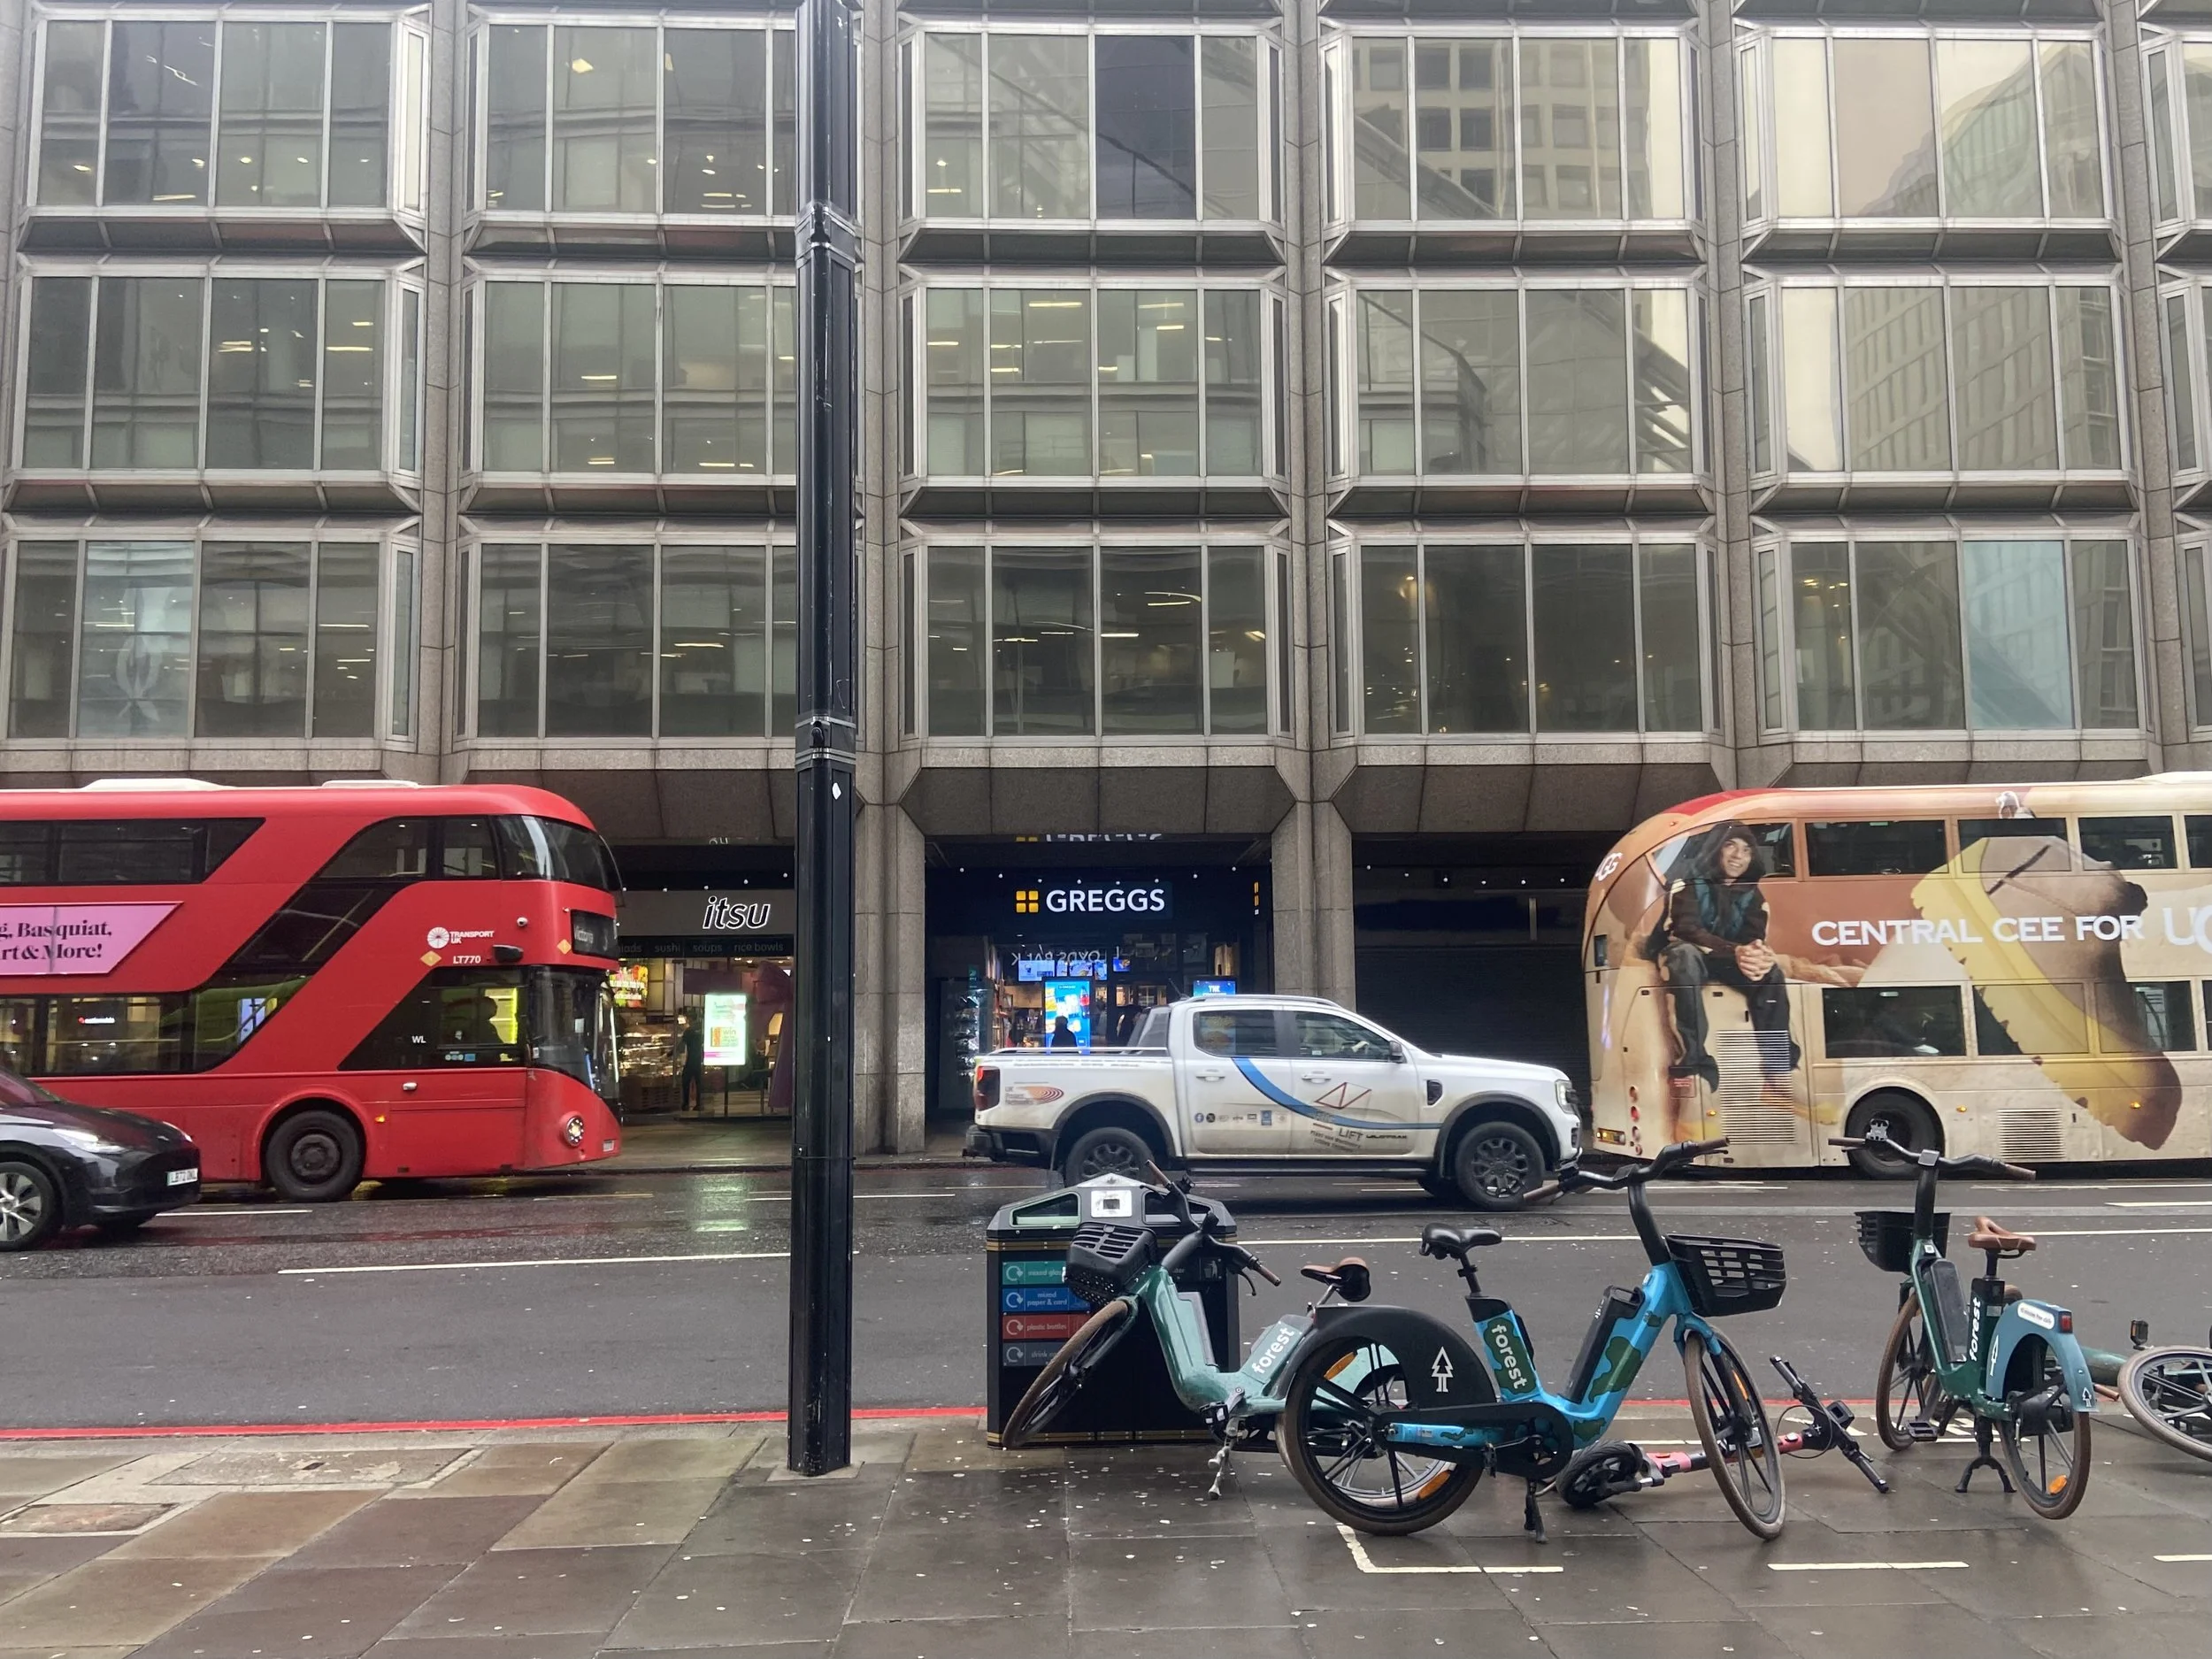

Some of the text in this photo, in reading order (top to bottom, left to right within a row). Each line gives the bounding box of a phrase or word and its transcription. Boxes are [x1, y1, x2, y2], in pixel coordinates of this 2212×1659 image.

[1046, 888, 1165, 912] GREGGS
[703, 895, 771, 929] itsu
[18, 919, 112, 940] Basquiat,
[1811, 918, 1984, 946] CENTRAL
[1992, 916, 2066, 942] CEE
[2075, 914, 2146, 941] FOR
[0, 943, 103, 960] rt & More!
[654, 943, 680, 953] sushi
[693, 943, 722, 954] soups
[734, 942, 751, 952] rice
[754, 941, 784, 952] bowls
[452, 956, 481, 964] LT770
[411, 1035, 426, 1044] WL
[1338, 1127, 1363, 1141] LIFT
[1970, 1297, 1981, 1362] forest
[1252, 1328, 1294, 1374] forest
[1491, 1324, 1528, 1389] forest
